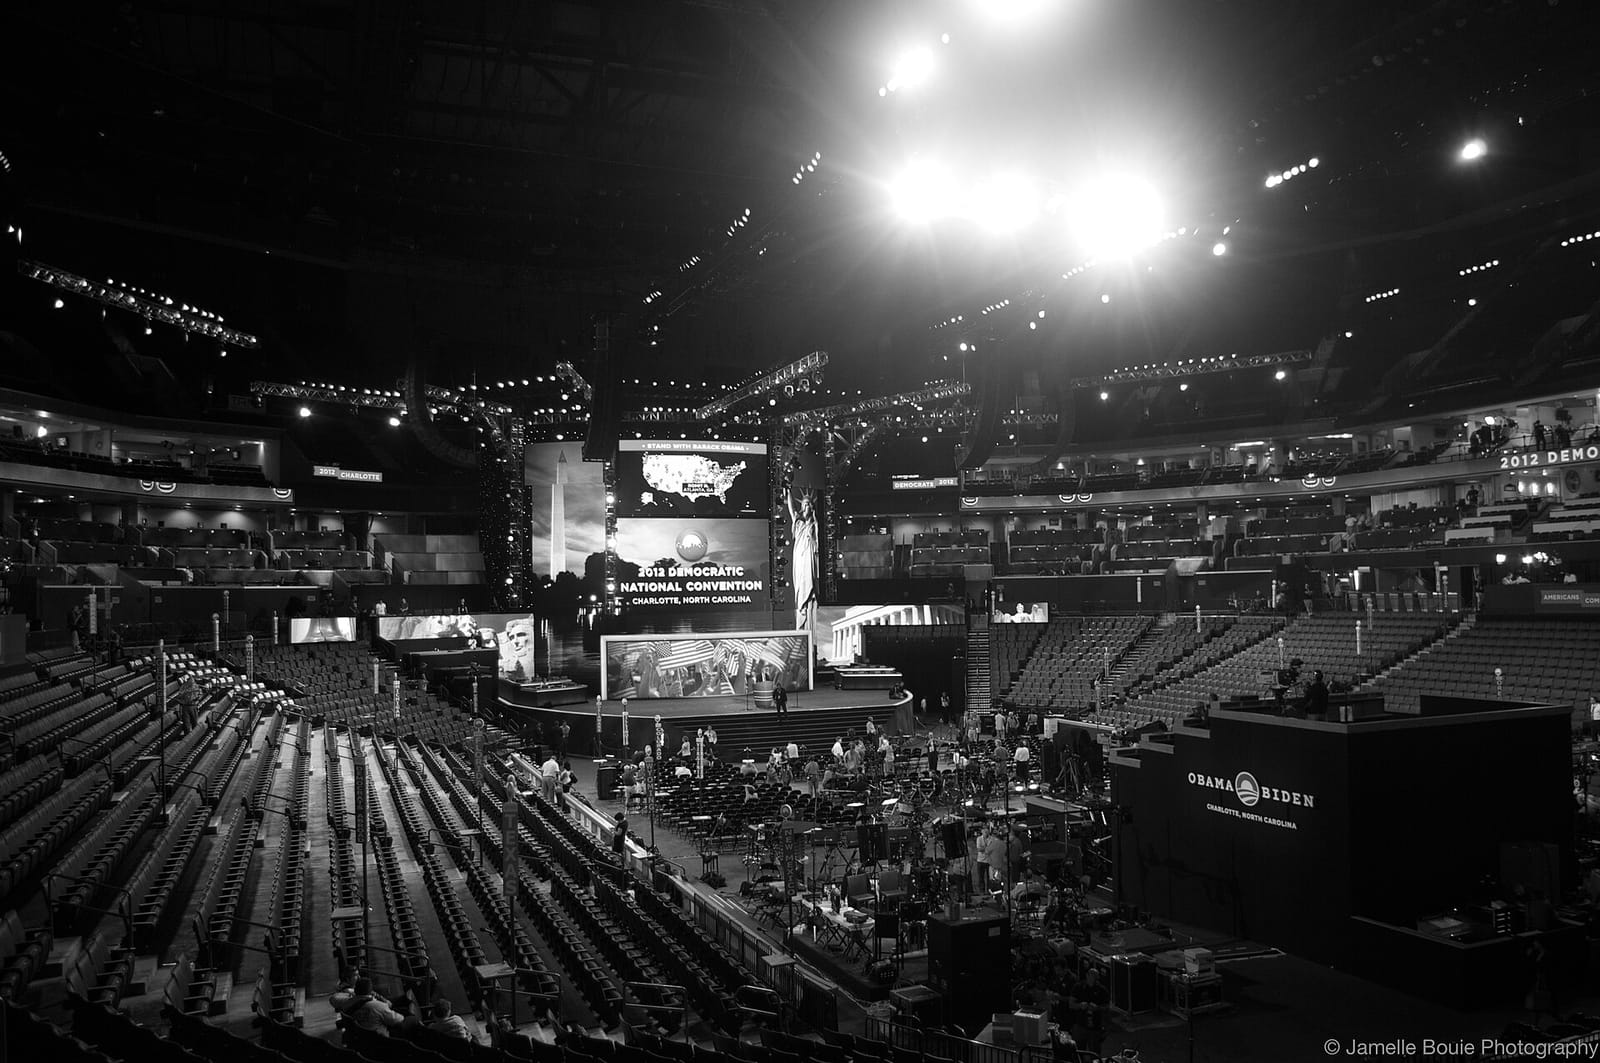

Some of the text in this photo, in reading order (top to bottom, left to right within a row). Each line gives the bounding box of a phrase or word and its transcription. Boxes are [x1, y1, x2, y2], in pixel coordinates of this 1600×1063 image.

[1500, 446, 1599, 469] 2012 DEMO
[319, 468, 380, 481] 2012 CHARLOTTE
[894, 481, 934, 489] DEMOCRATS
[638, 566, 744, 577] 2012 DEMOCRATIC
[620, 580, 763, 592] NATIONAL CONVENTION
[632, 595, 752, 606] CHARLOTTE, NORTH CAROLINA
[1543, 593, 1580, 601] AMERICANS
[1187, 772, 1315, 808] OBAMA BIDEN
[1206, 803, 1298, 830] CHARLOTTE, NORTH CAROLINA
[504, 813, 517, 895] TEXAS
[784, 829, 795, 896] NEW MEXICO
